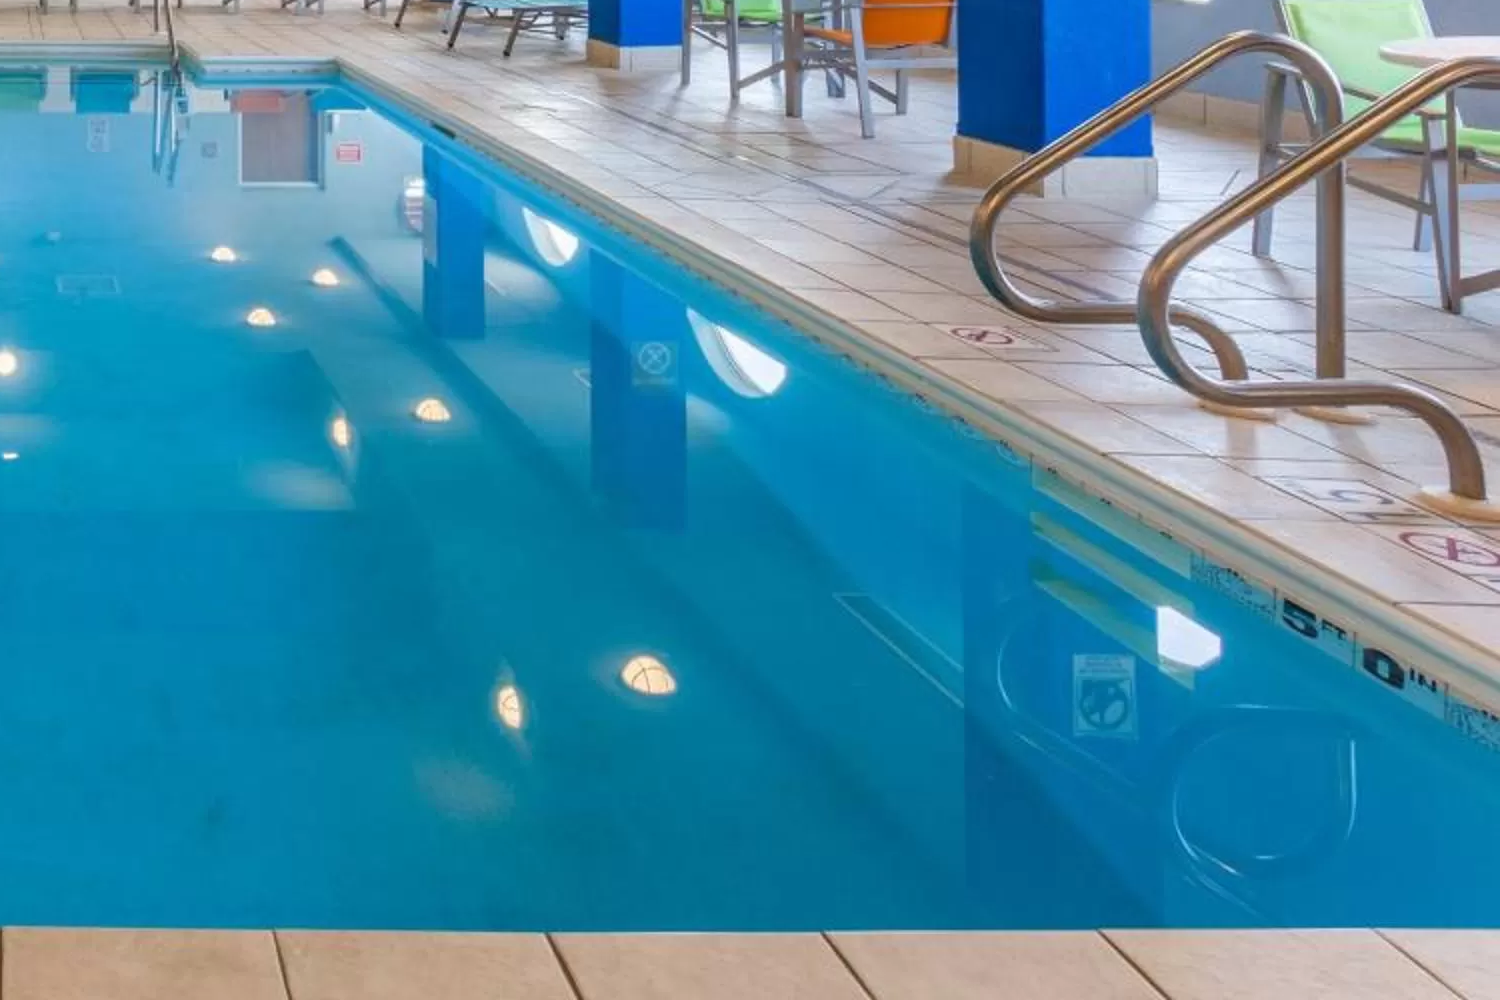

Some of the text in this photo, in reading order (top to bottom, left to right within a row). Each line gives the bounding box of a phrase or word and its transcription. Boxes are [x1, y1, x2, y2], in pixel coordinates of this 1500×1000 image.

[1282, 598, 1319, 639] 5
[1362, 647, 1405, 691] 0
[1409, 667, 1438, 693] IN
